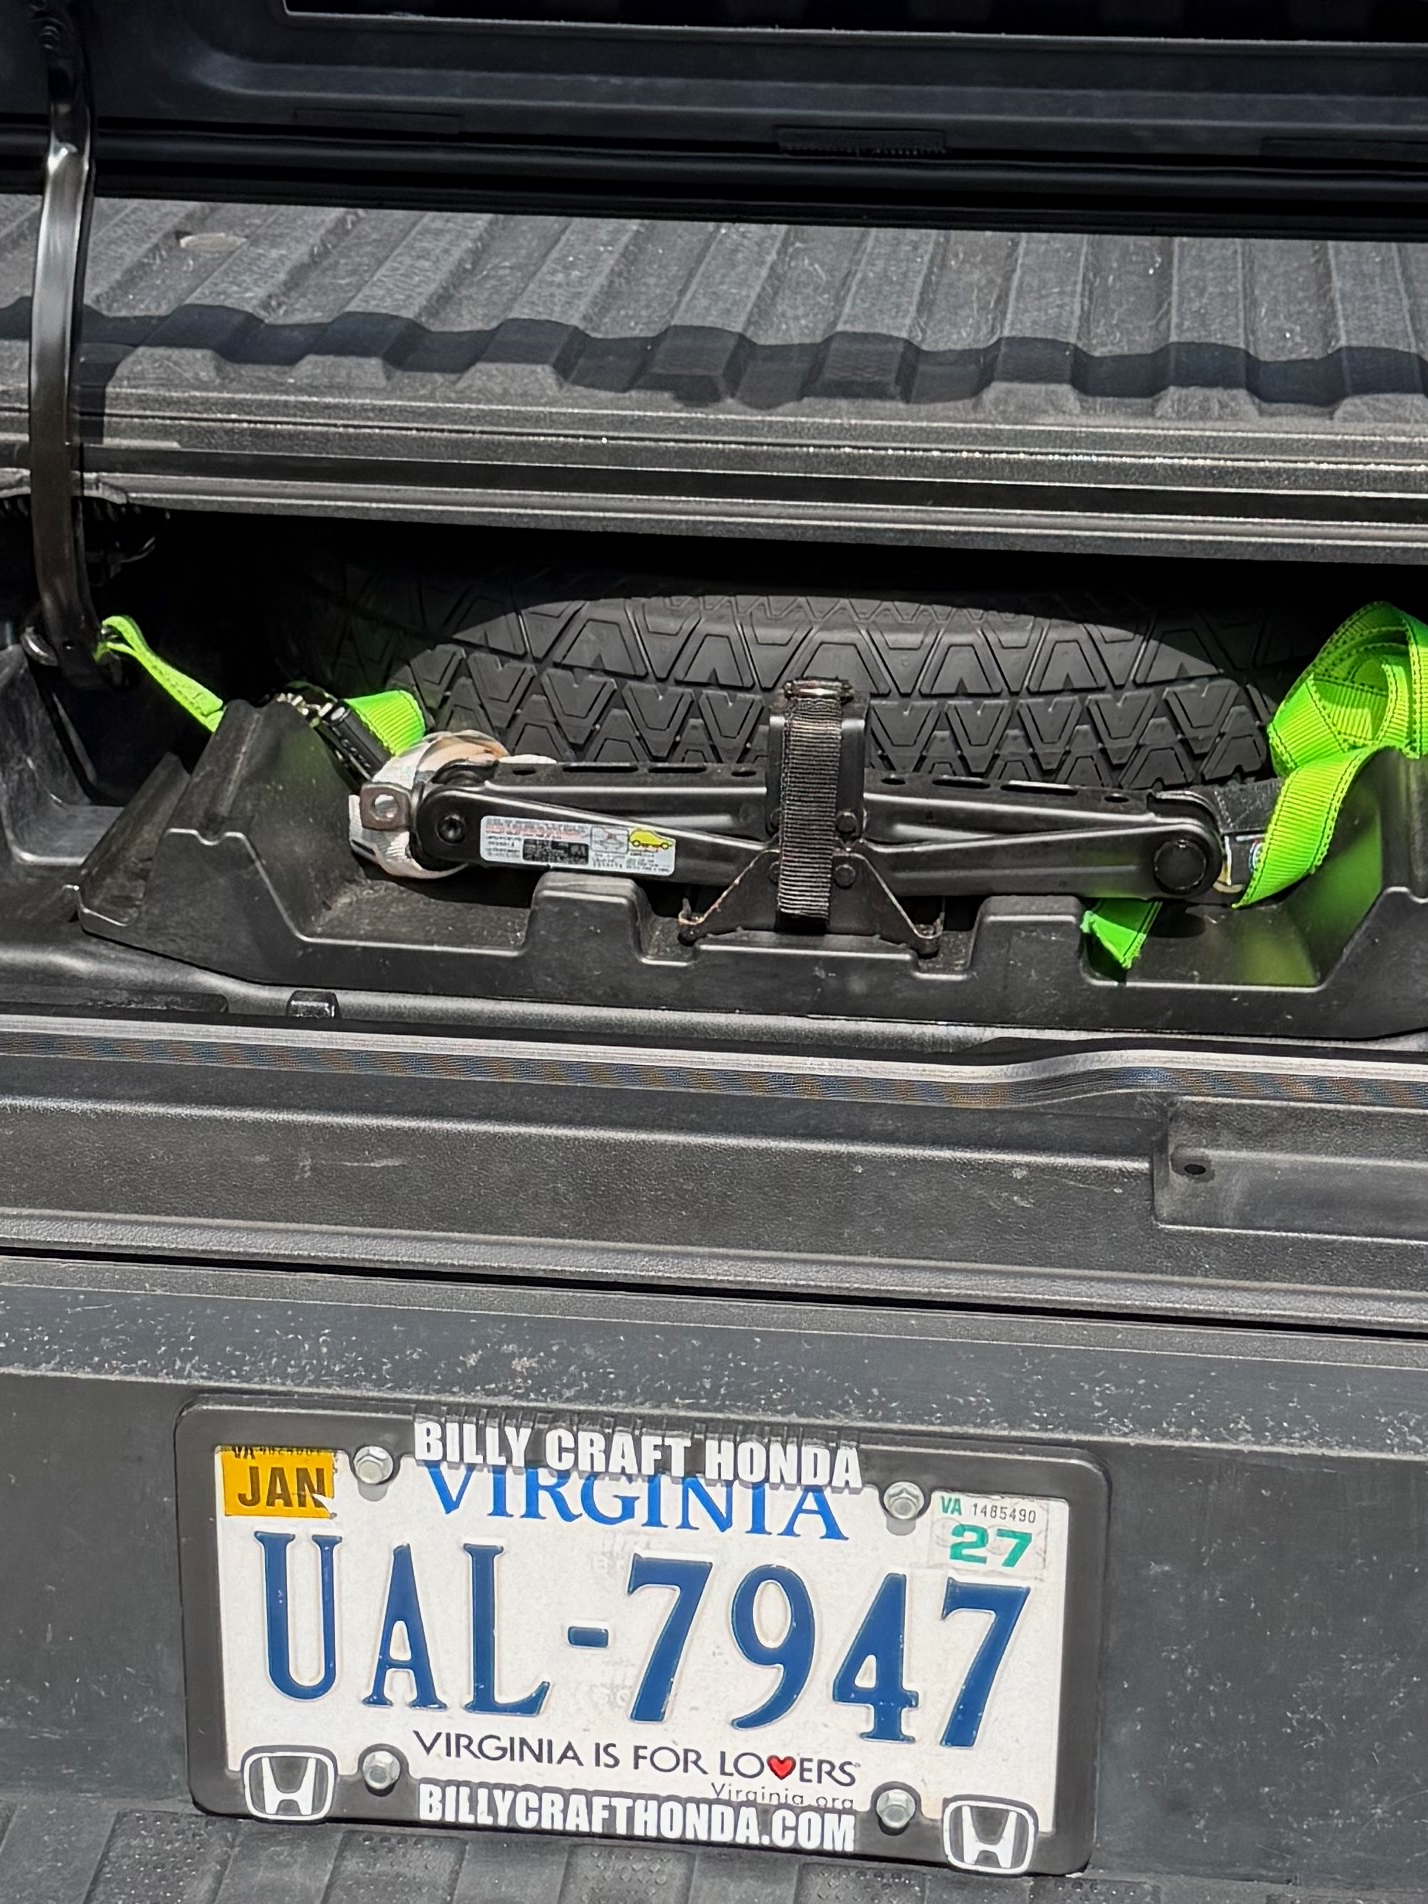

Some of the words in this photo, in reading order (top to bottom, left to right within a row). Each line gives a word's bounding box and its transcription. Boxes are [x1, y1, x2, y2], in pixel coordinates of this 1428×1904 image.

[415, 1421, 534, 1468] BILLY
[545, 1429, 692, 1477] CRAFT
[705, 1439, 863, 1488] HONDA
[238, 1466, 327, 1508] JAN
[424, 1460, 850, 1542] VIRGINIA
[940, 1495, 963, 1517] VA
[949, 1523, 1033, 1568] 27
[253, 1531, 1032, 1748] UAL-7947
[413, 1730, 584, 1768] VIRGINIA
[594, 1742, 621, 1770] IS
[633, 1745, 709, 1775] FOR
[419, 1782, 856, 1853] BILLYCRAFTHONDA.COM
[711, 1781, 854, 1810] Virginiaorg
